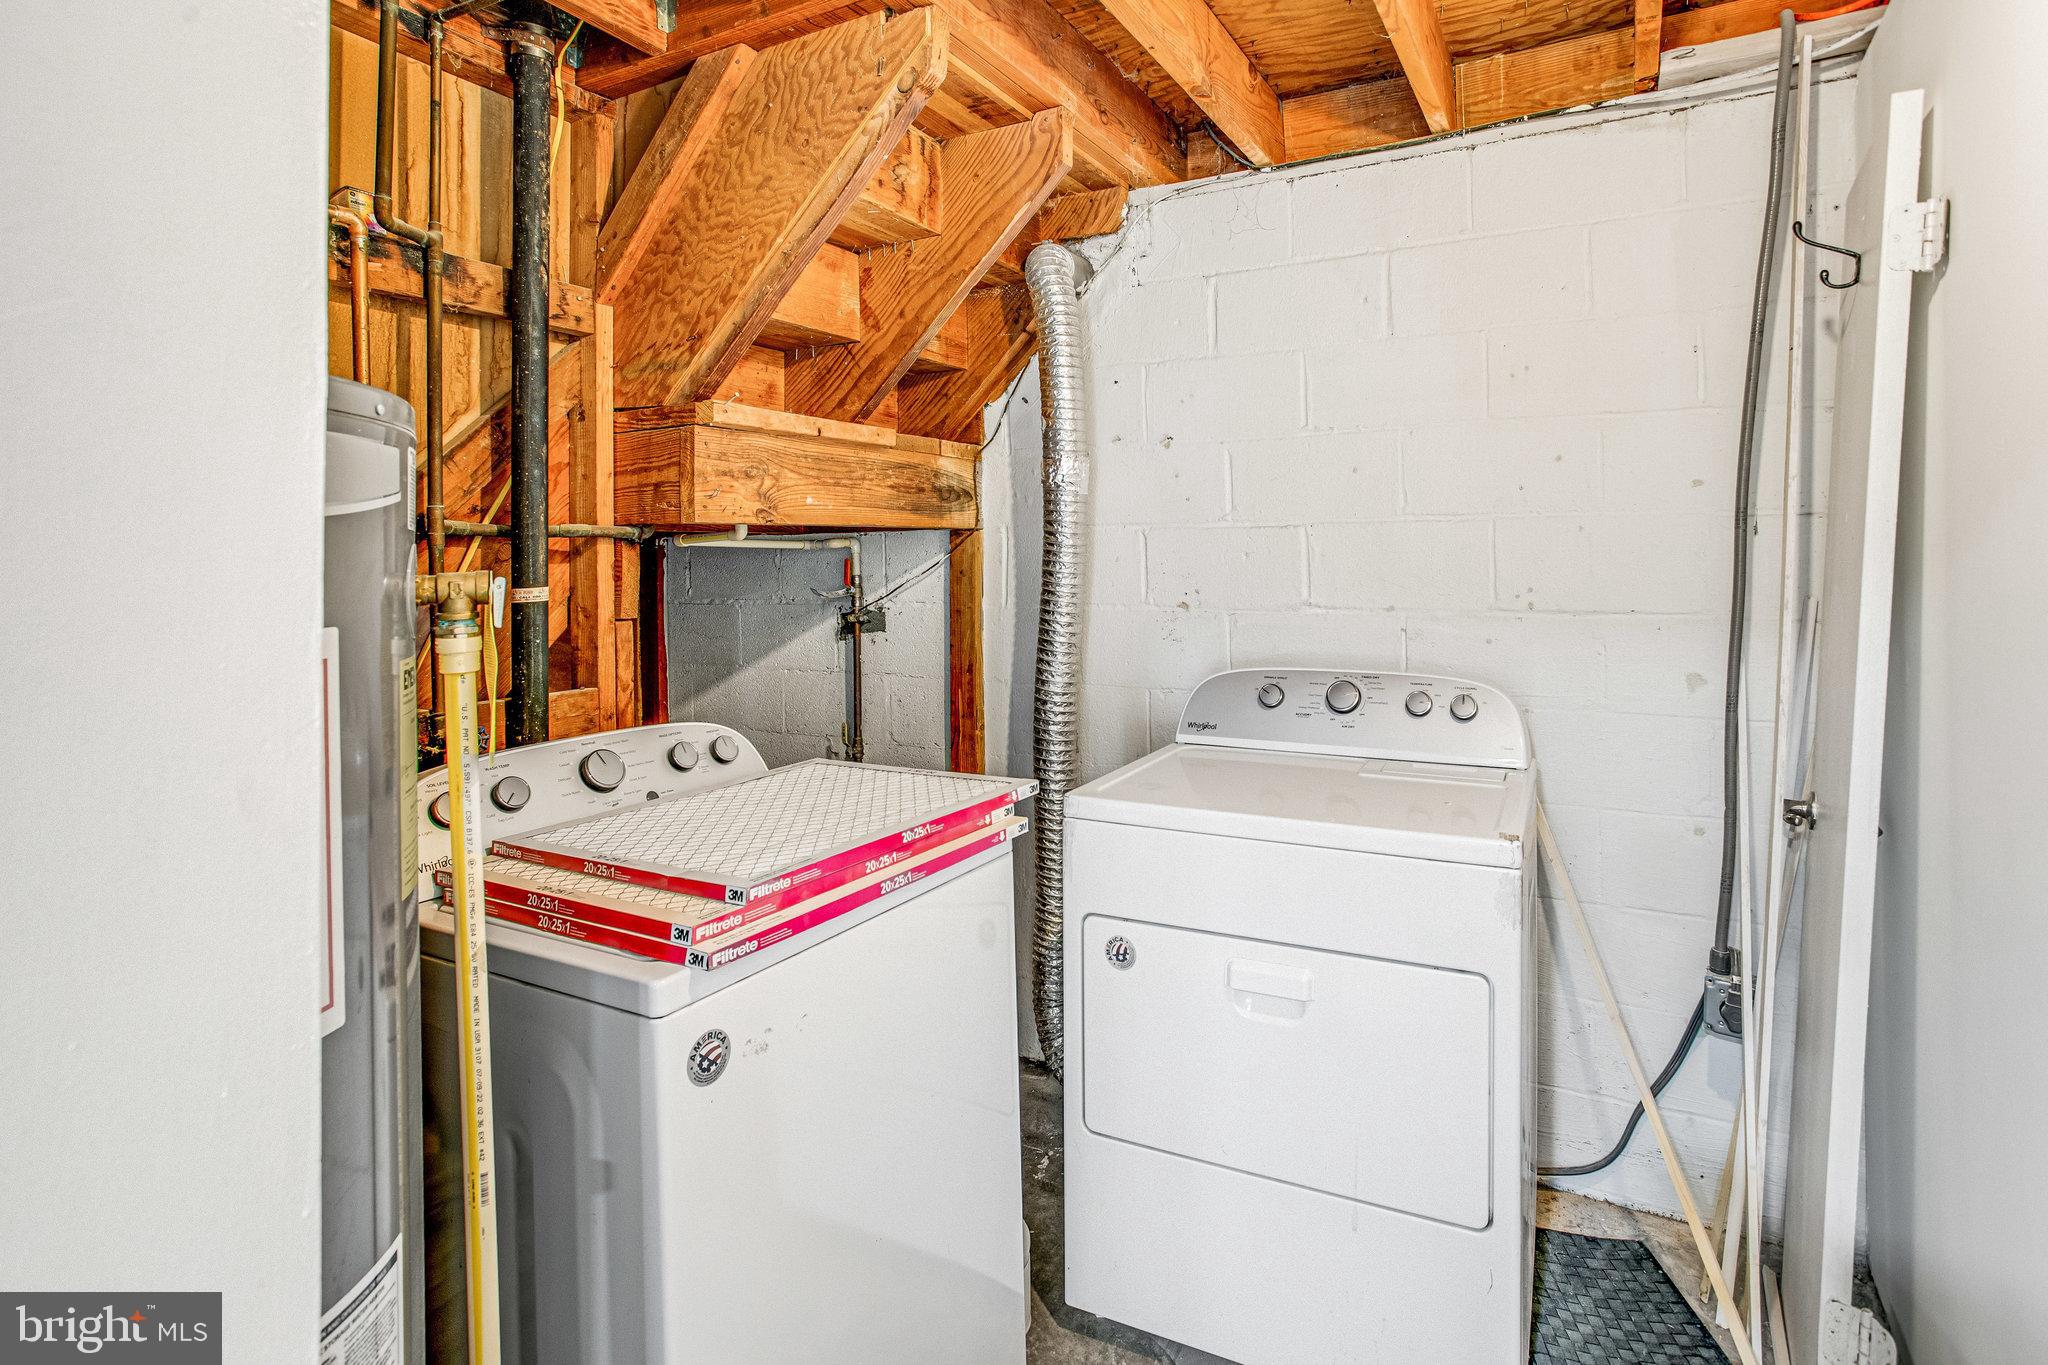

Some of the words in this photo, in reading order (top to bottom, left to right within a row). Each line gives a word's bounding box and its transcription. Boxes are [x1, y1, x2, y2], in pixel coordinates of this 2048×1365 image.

[1187, 721, 1218, 732] Whirlpool
[1029, 783, 1039, 794] 3M
[1004, 806, 1014, 817] 3M
[901, 823, 931, 844] 20x25x1
[1018, 821, 1028, 833] 3M
[493, 843, 522, 858] Filtrete
[583, 861, 615, 878] 20x25x1
[865, 852, 897, 874] 20x25x1
[728, 889, 743, 902] 3M
[749, 878, 791, 901] Filtrete
[880, 872, 912, 895] 20x25x1
[527, 893, 559, 911] 20x25x1
[538, 915, 570, 934] 20x25x1
[673, 927, 689, 942] 3M
[695, 914, 743, 940] Filtrete
[688, 952, 704, 967] 3M
[711, 940, 758, 967] Filtrete
[474, 1030, 482, 1044] USA
[690, 1031, 727, 1062] AMERICA
